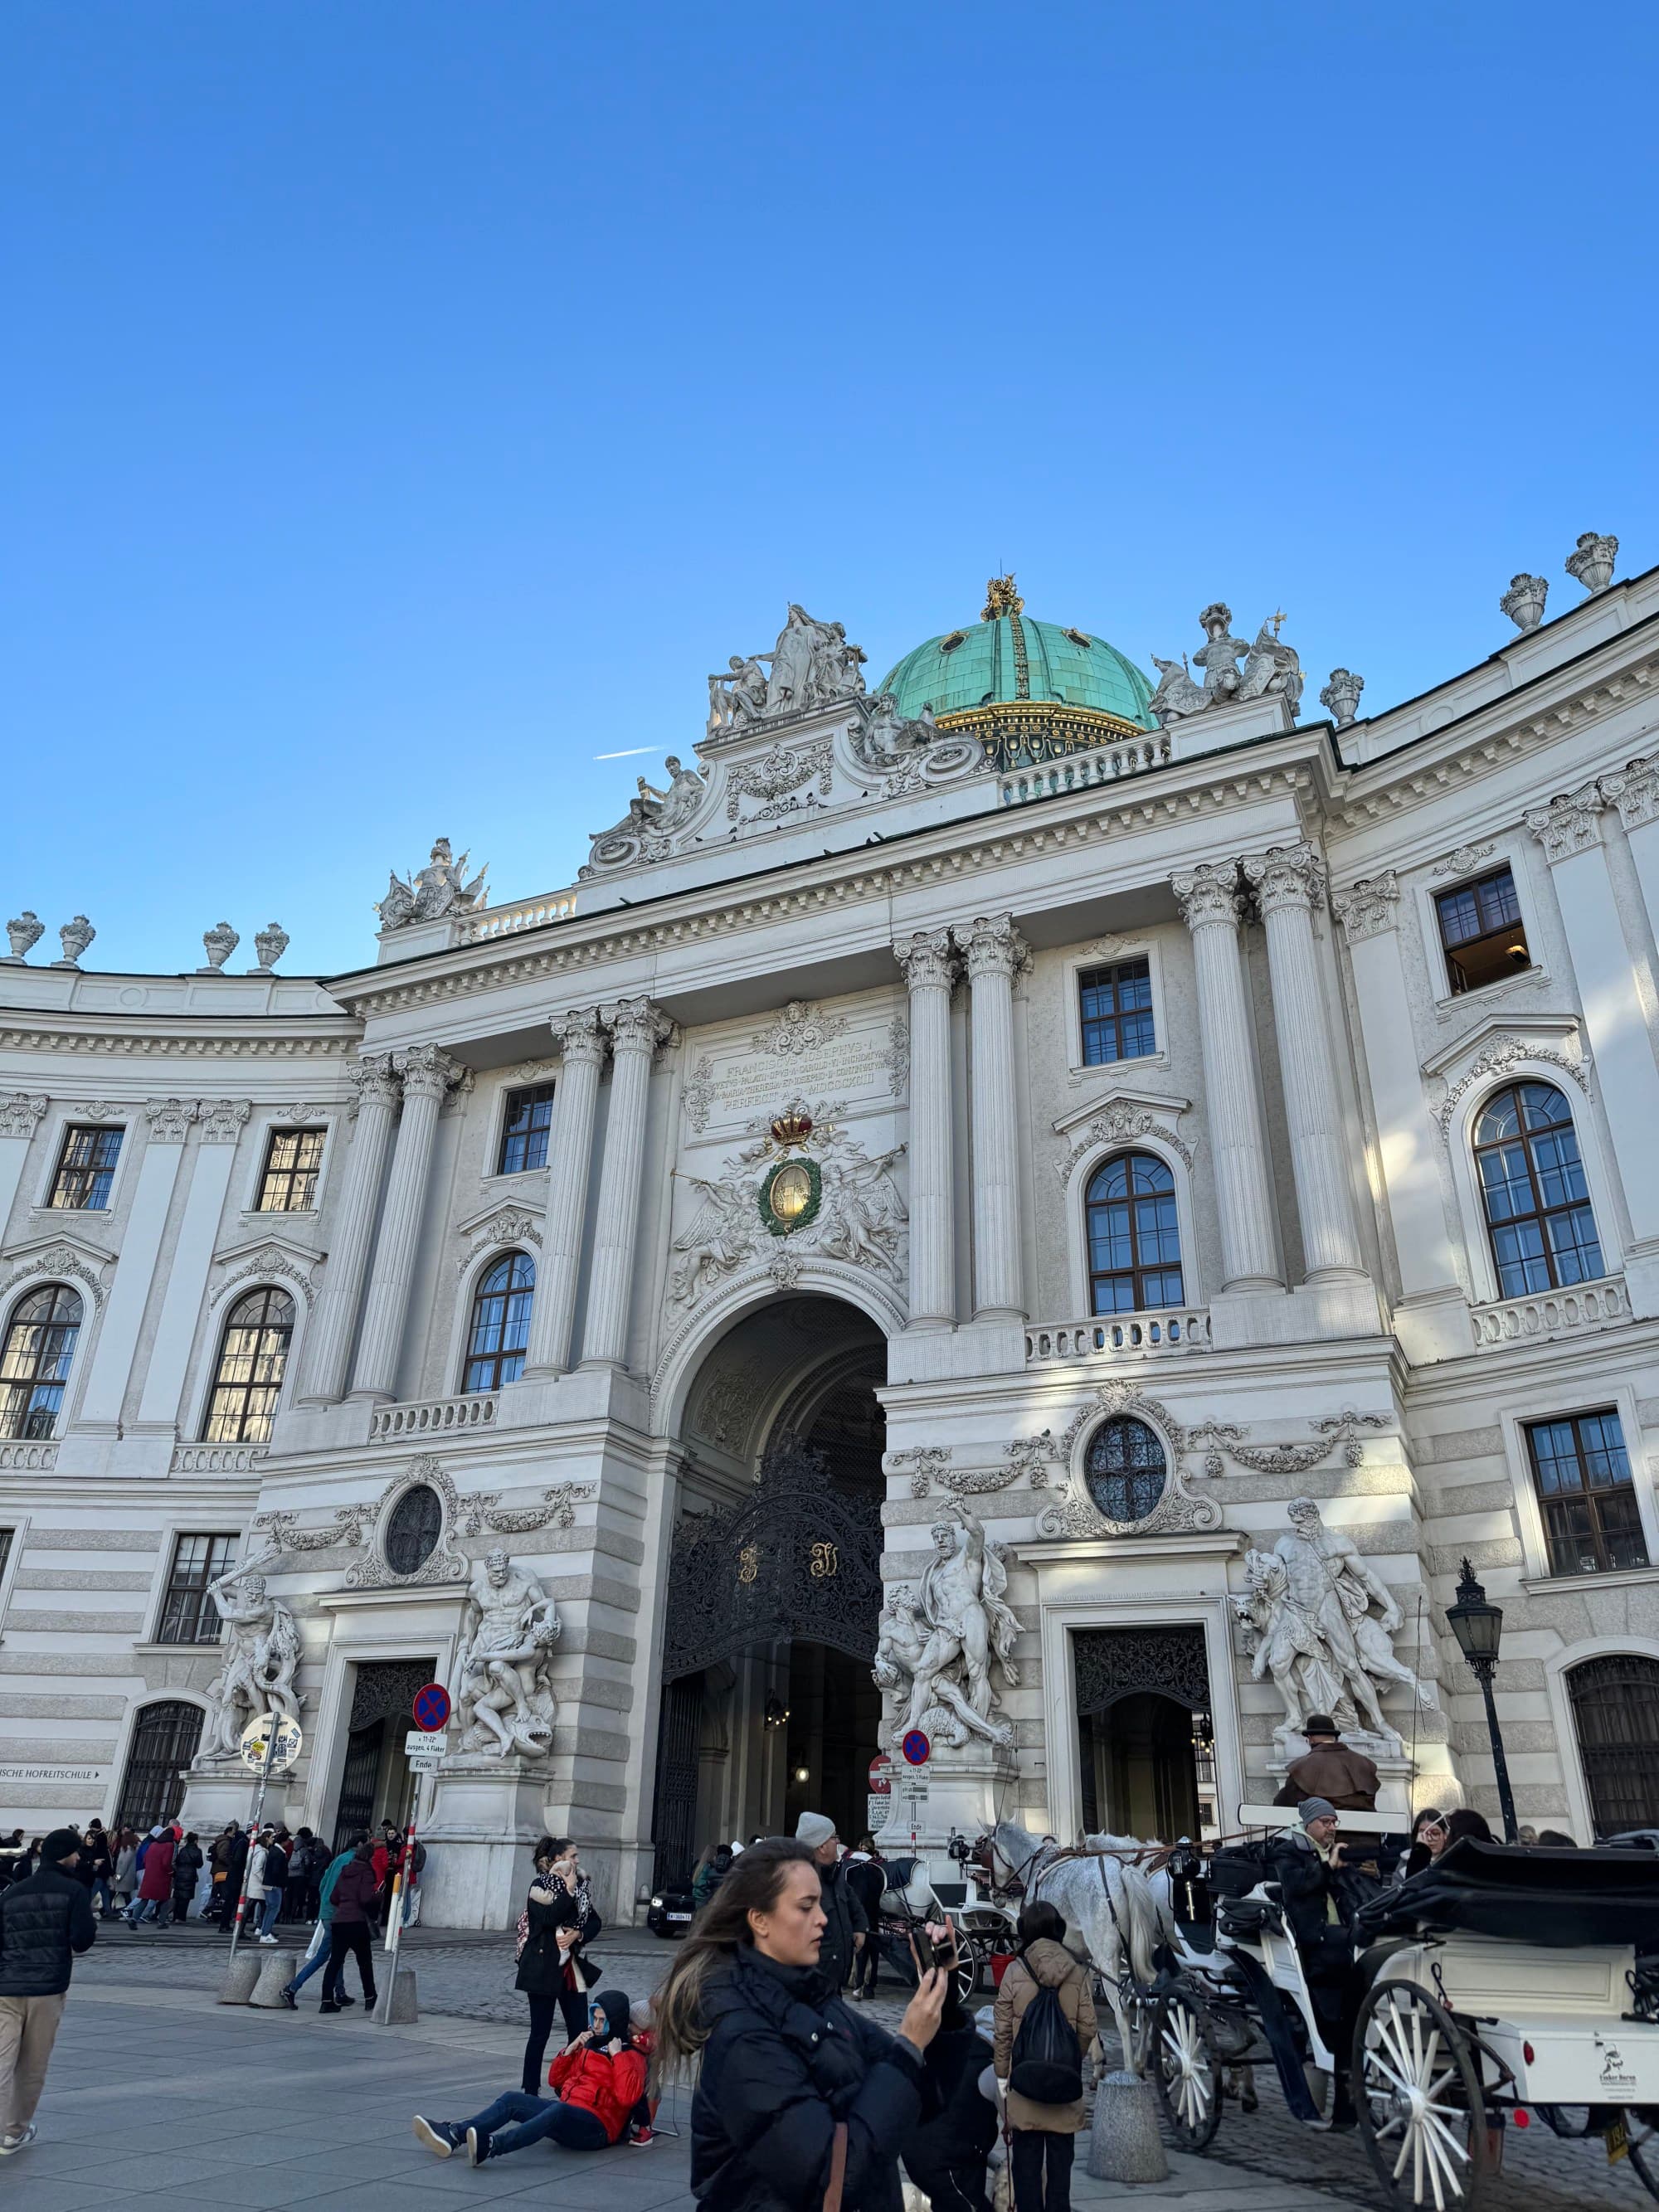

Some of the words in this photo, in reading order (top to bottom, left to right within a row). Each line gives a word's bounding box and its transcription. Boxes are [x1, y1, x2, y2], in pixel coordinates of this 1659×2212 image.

[727, 1055, 797, 1077] FRANCISCVS
[804, 1042, 863, 1062] IOSEPHVS
[416, 1759, 432, 1768] Ende
[25, 1769, 92, 1779] HOFREITSCHULE
